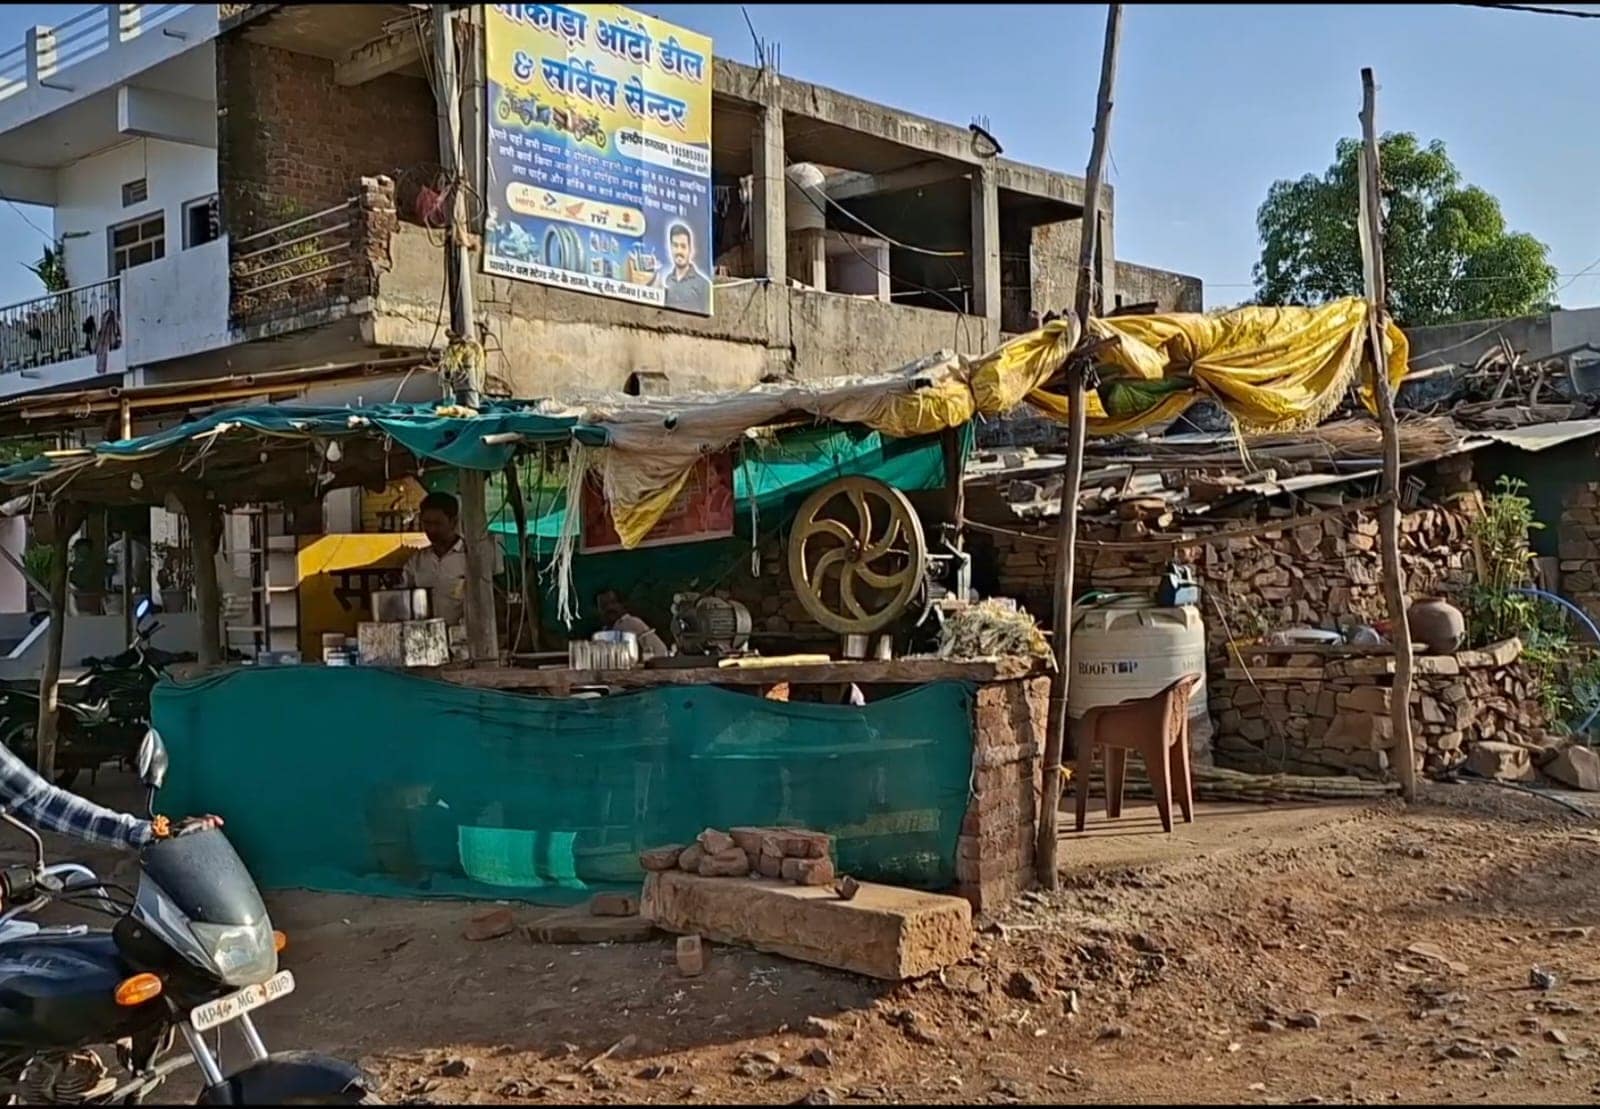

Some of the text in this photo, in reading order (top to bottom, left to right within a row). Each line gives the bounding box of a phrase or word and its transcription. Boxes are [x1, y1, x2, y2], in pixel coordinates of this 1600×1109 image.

[596, 16, 651, 63] ऑटो
[659, 35, 703, 79] डील
[514, 52, 687, 127] & सर्विस सेन्टर
